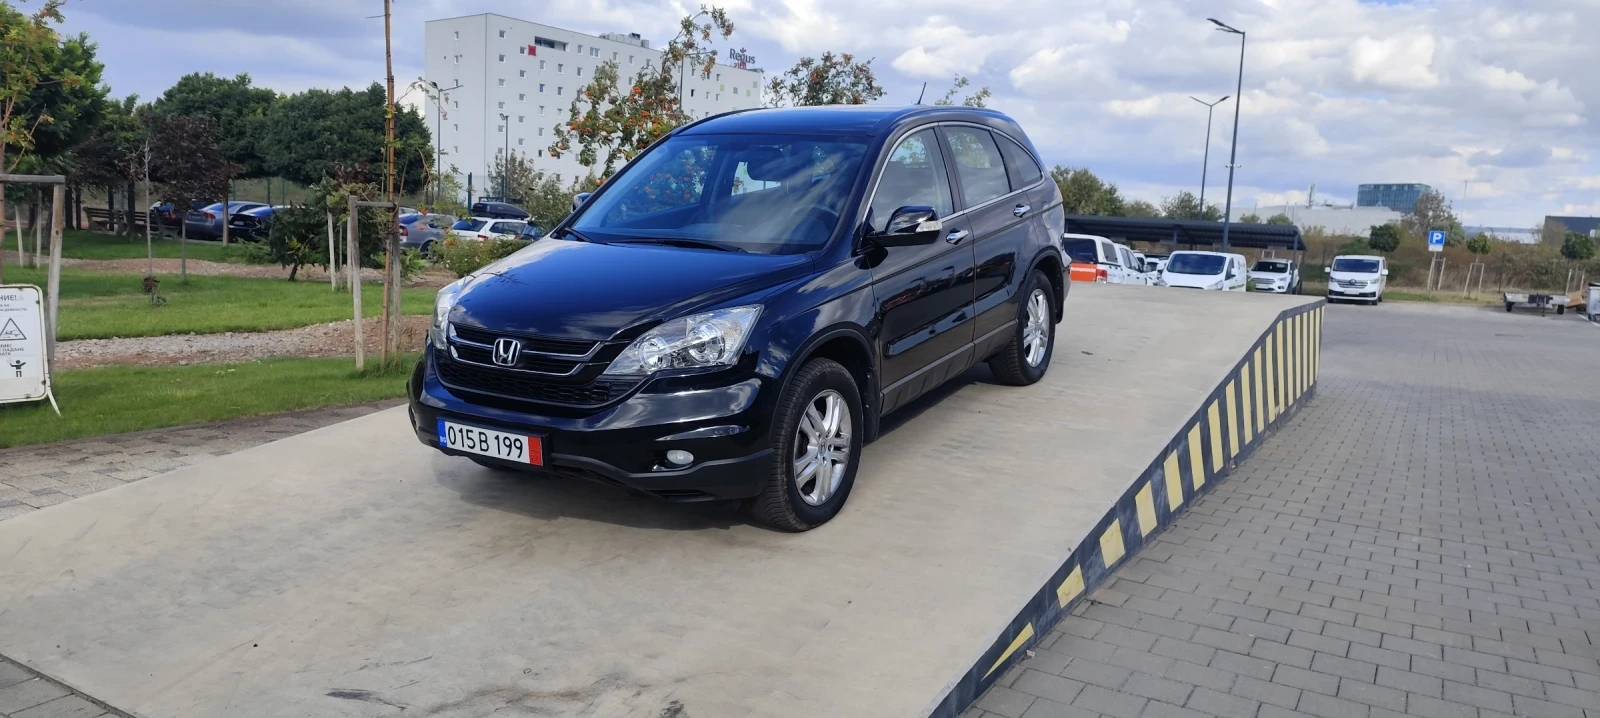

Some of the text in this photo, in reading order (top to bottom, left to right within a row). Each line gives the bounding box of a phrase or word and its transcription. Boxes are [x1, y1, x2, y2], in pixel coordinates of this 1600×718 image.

[729, 48, 756, 64] Regus
[1432, 232, 1442, 243] P
[494, 434, 524, 459] 199
